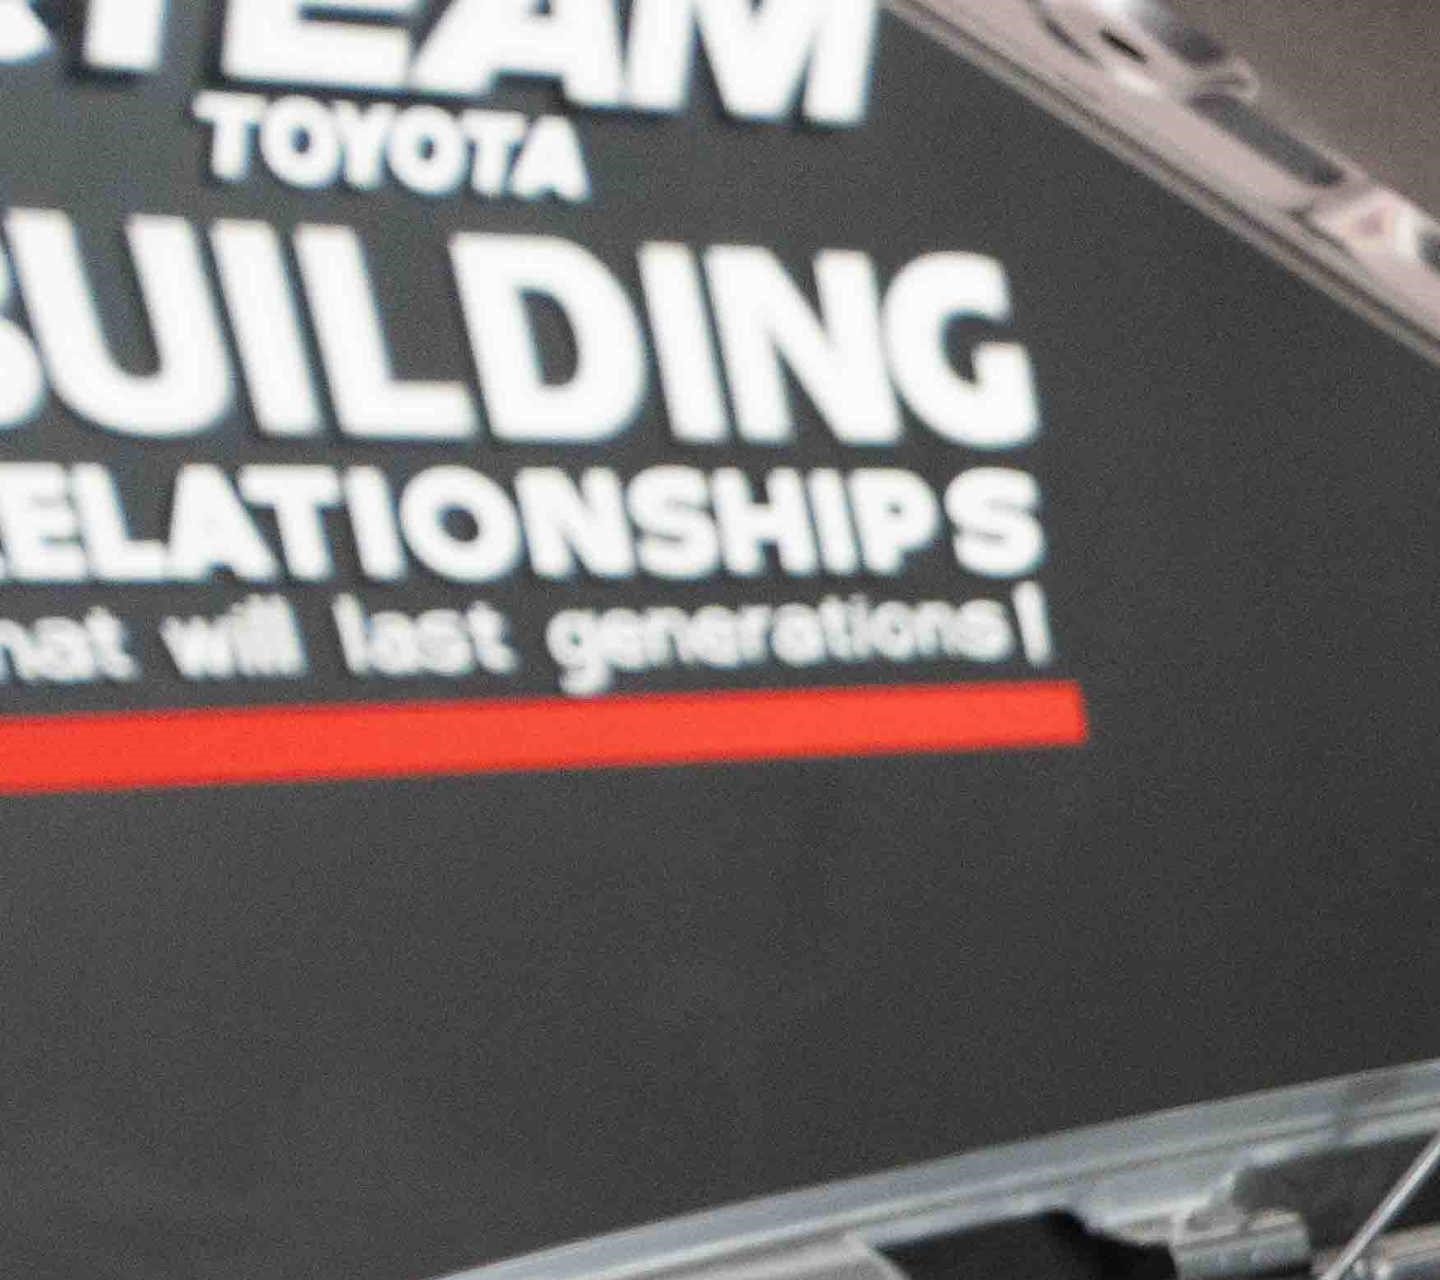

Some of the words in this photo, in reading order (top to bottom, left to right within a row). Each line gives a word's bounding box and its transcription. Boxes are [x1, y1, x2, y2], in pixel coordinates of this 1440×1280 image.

[192, 88, 592, 201] TOYOTA
[0, 461, 1047, 583] ELATIONSHIPS
[0, 605, 140, 683] hat
[158, 593, 309, 680] will
[332, 592, 520, 677] last
